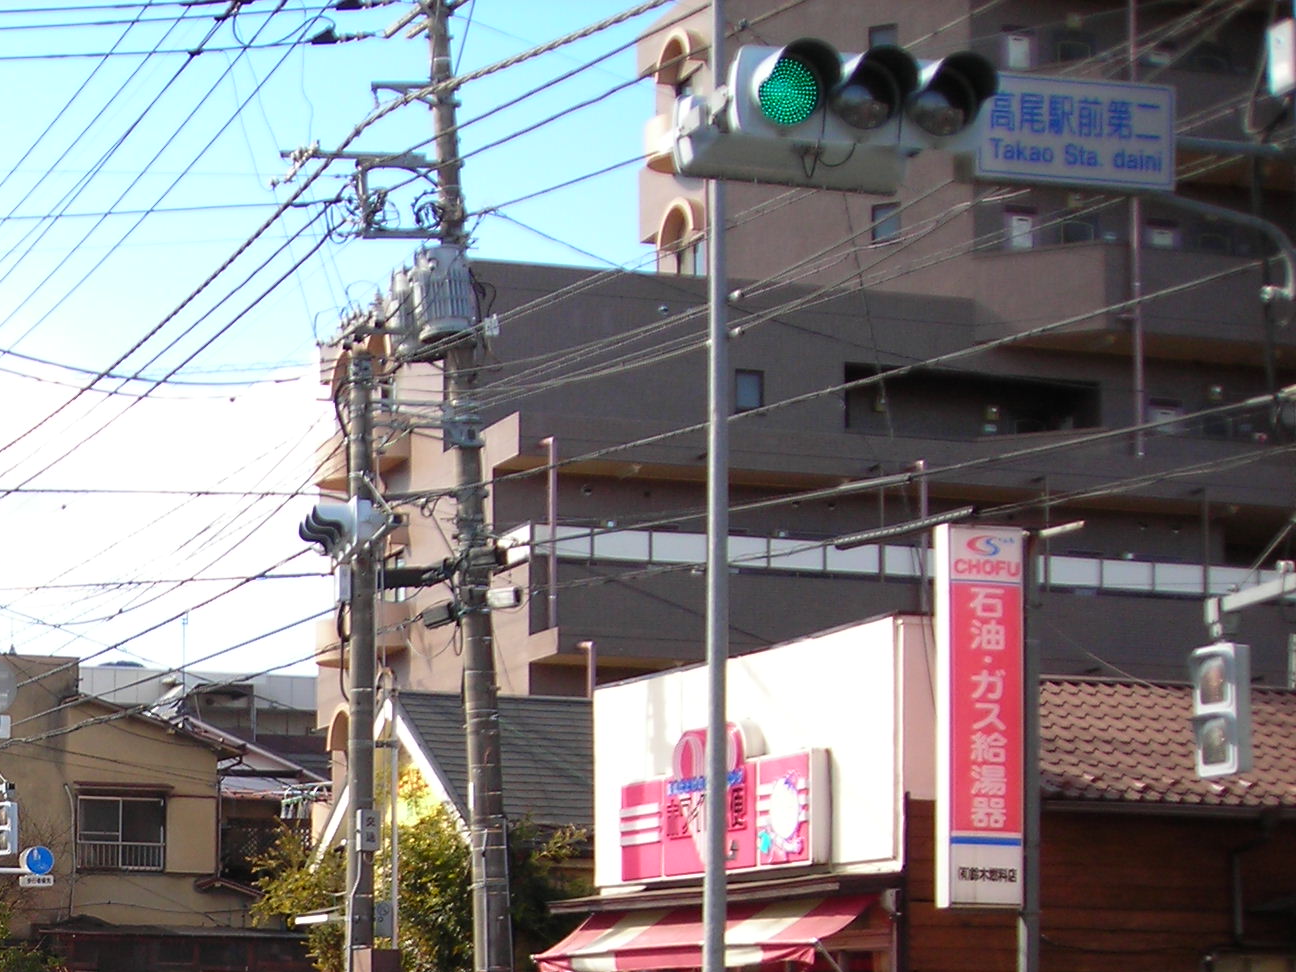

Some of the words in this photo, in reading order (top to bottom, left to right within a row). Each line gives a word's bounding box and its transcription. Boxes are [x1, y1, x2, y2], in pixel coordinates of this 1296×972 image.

[990, 92, 1161, 140] 高尾駅前第二
[988, 137, 1054, 164] Takao
[1113, 151, 1162, 172] daini
[954, 558, 1021, 577] CHOFU
[969, 586, 1007, 829] 石油・ガス給湯器
